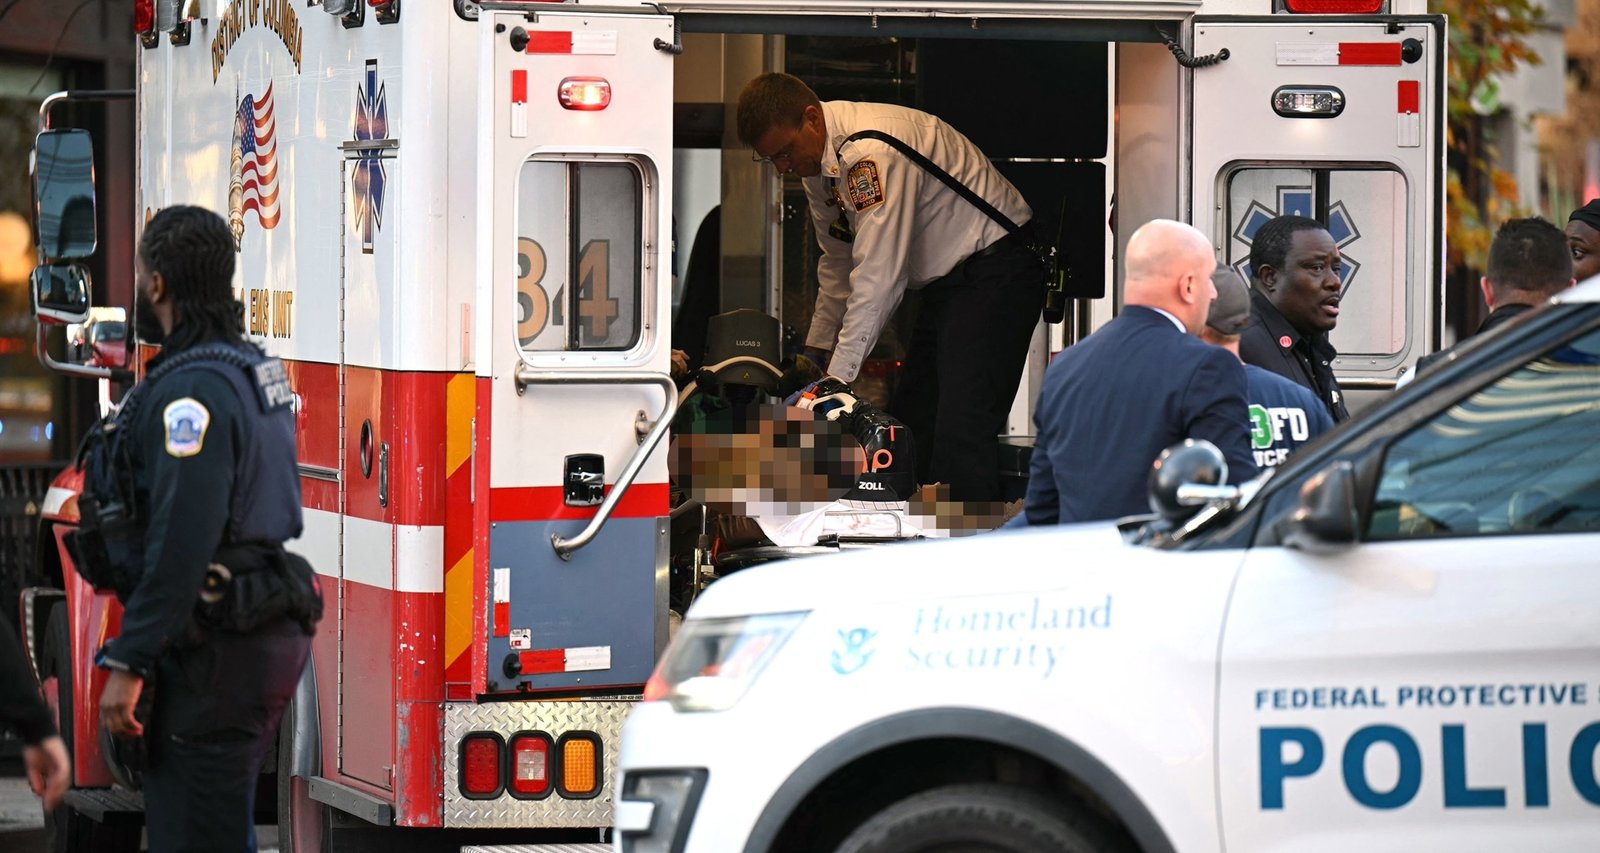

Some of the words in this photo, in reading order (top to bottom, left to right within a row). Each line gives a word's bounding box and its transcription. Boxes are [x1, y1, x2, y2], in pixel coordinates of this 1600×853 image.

[250, 288, 269, 338] EMS
[273, 290, 293, 339] UNIT
[1248, 404, 1309, 449] 3FD
[1253, 448, 1289, 467] UCK
[858, 481, 885, 491] ZOLL
[914, 592, 1114, 635] Homeland
[904, 636, 1067, 680] Security
[1255, 687, 1387, 710] FEDERAL
[1398, 683, 1588, 707] PROTECTIVE
